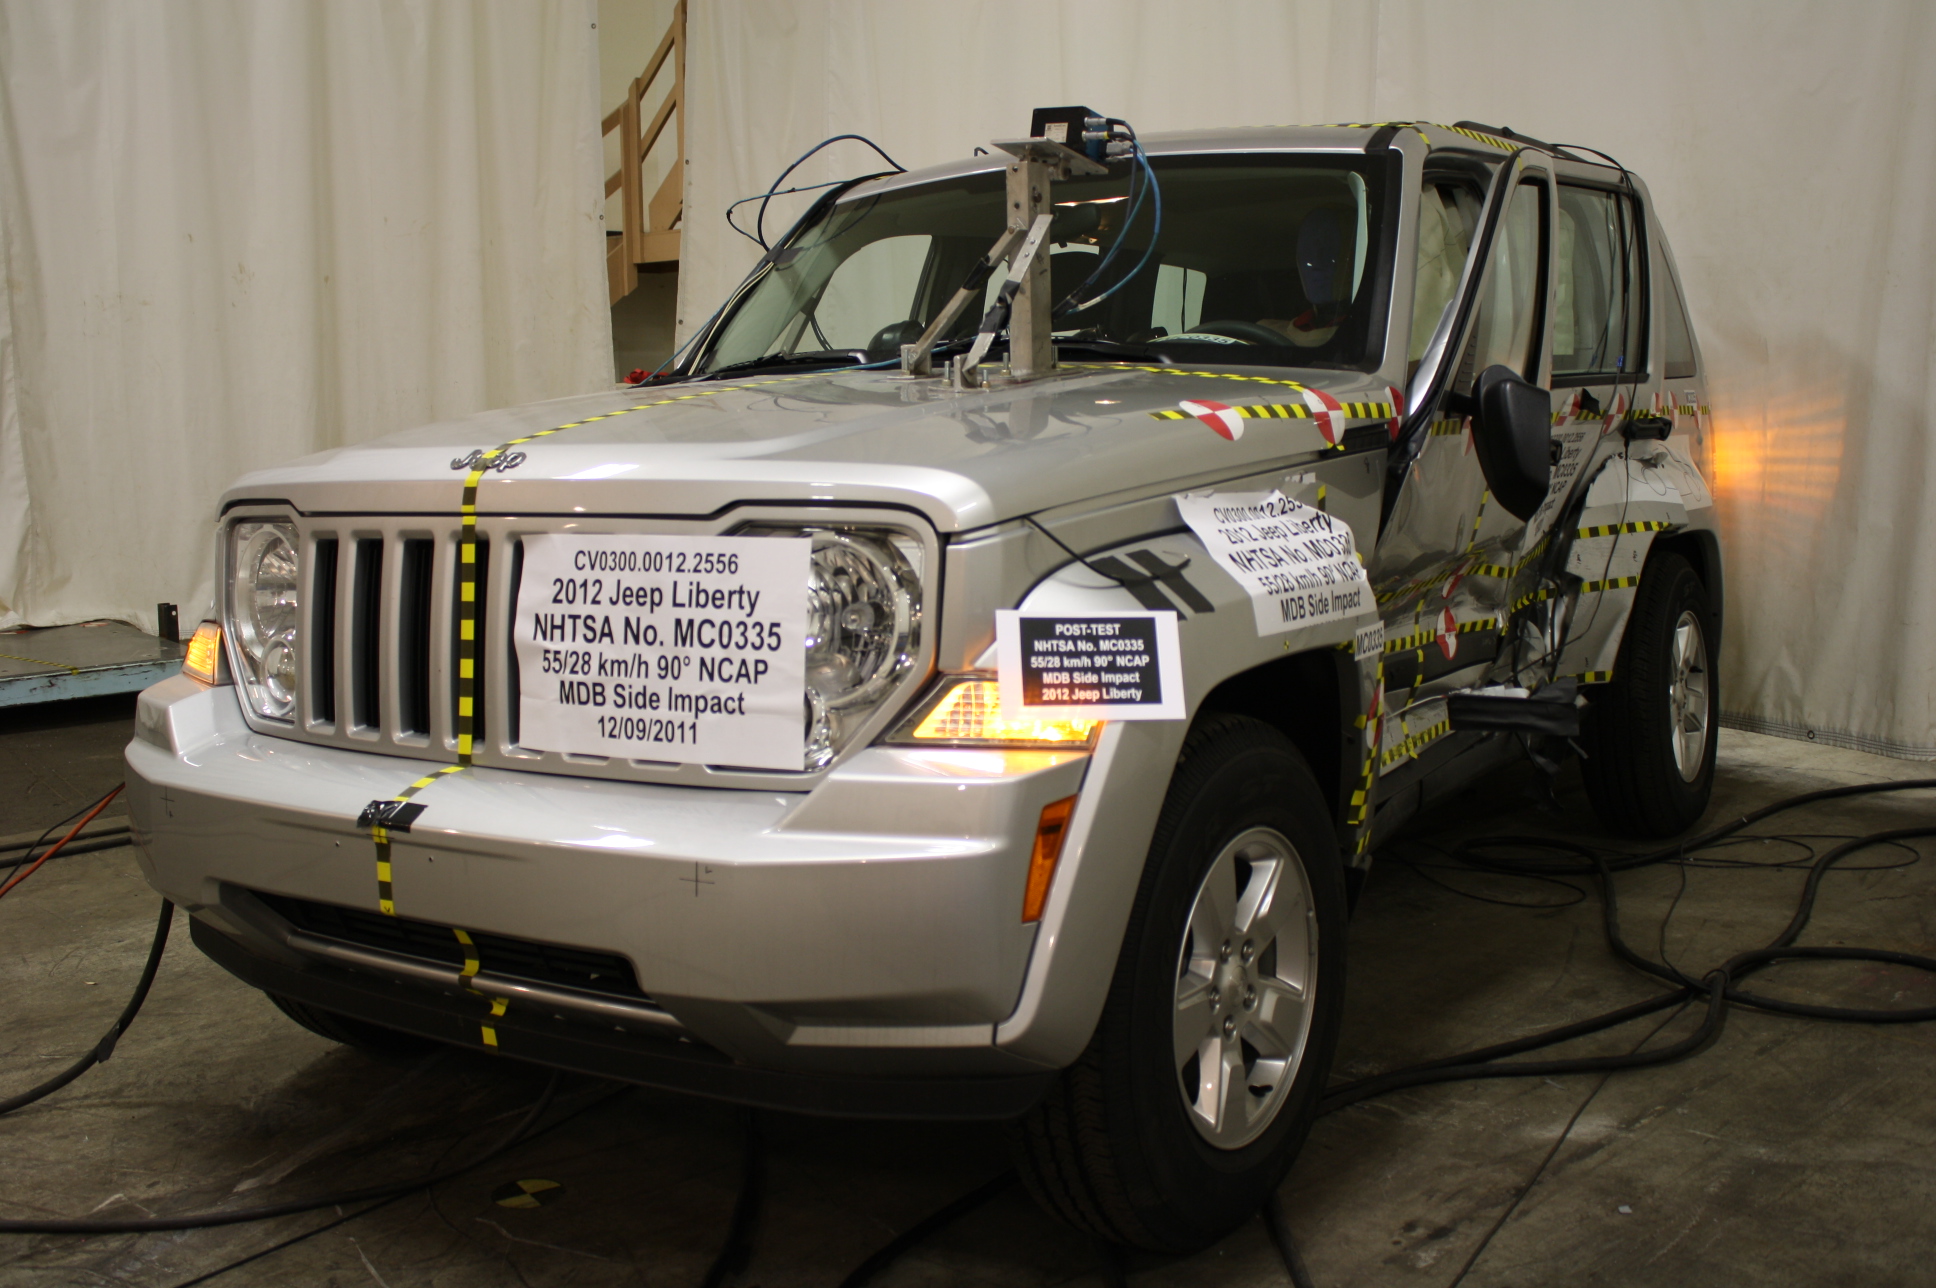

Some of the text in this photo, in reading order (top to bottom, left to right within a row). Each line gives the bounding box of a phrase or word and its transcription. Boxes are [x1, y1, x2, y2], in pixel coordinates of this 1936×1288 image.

[1213, 495, 1303, 524] CV0300.0012.25
[1218, 511, 1333, 544] 2012 Jeep Liberty
[573, 549, 739, 575] CV0300.0012.2556
[1228, 547, 1291, 574] NHTSA
[1279, 544, 1313, 565] No.
[1258, 573, 1295, 595] 55/28
[1288, 568, 1323, 590] km/h
[551, 578, 760, 618] 2012 Jeep Liberty
[1280, 587, 1361, 623] MDB Side Impact
[532, 613, 781, 651] NHTSA No. MC0335
[1055, 623, 1121, 636] POST-TEST
[1034, 639, 1144, 652] NHTSA No. MC0335
[542, 649, 769, 684] 55/28 km/h 90° NCAP
[1030, 654, 1150, 668] 55/28 km/h 90° NCAP
[1042, 671, 1140, 685] MDB Side Impact
[559, 680, 746, 720] MDB Side Impact
[1042, 687, 1142, 702] 2012 Jeep Liberty
[597, 715, 698, 744] 12/09/2011
